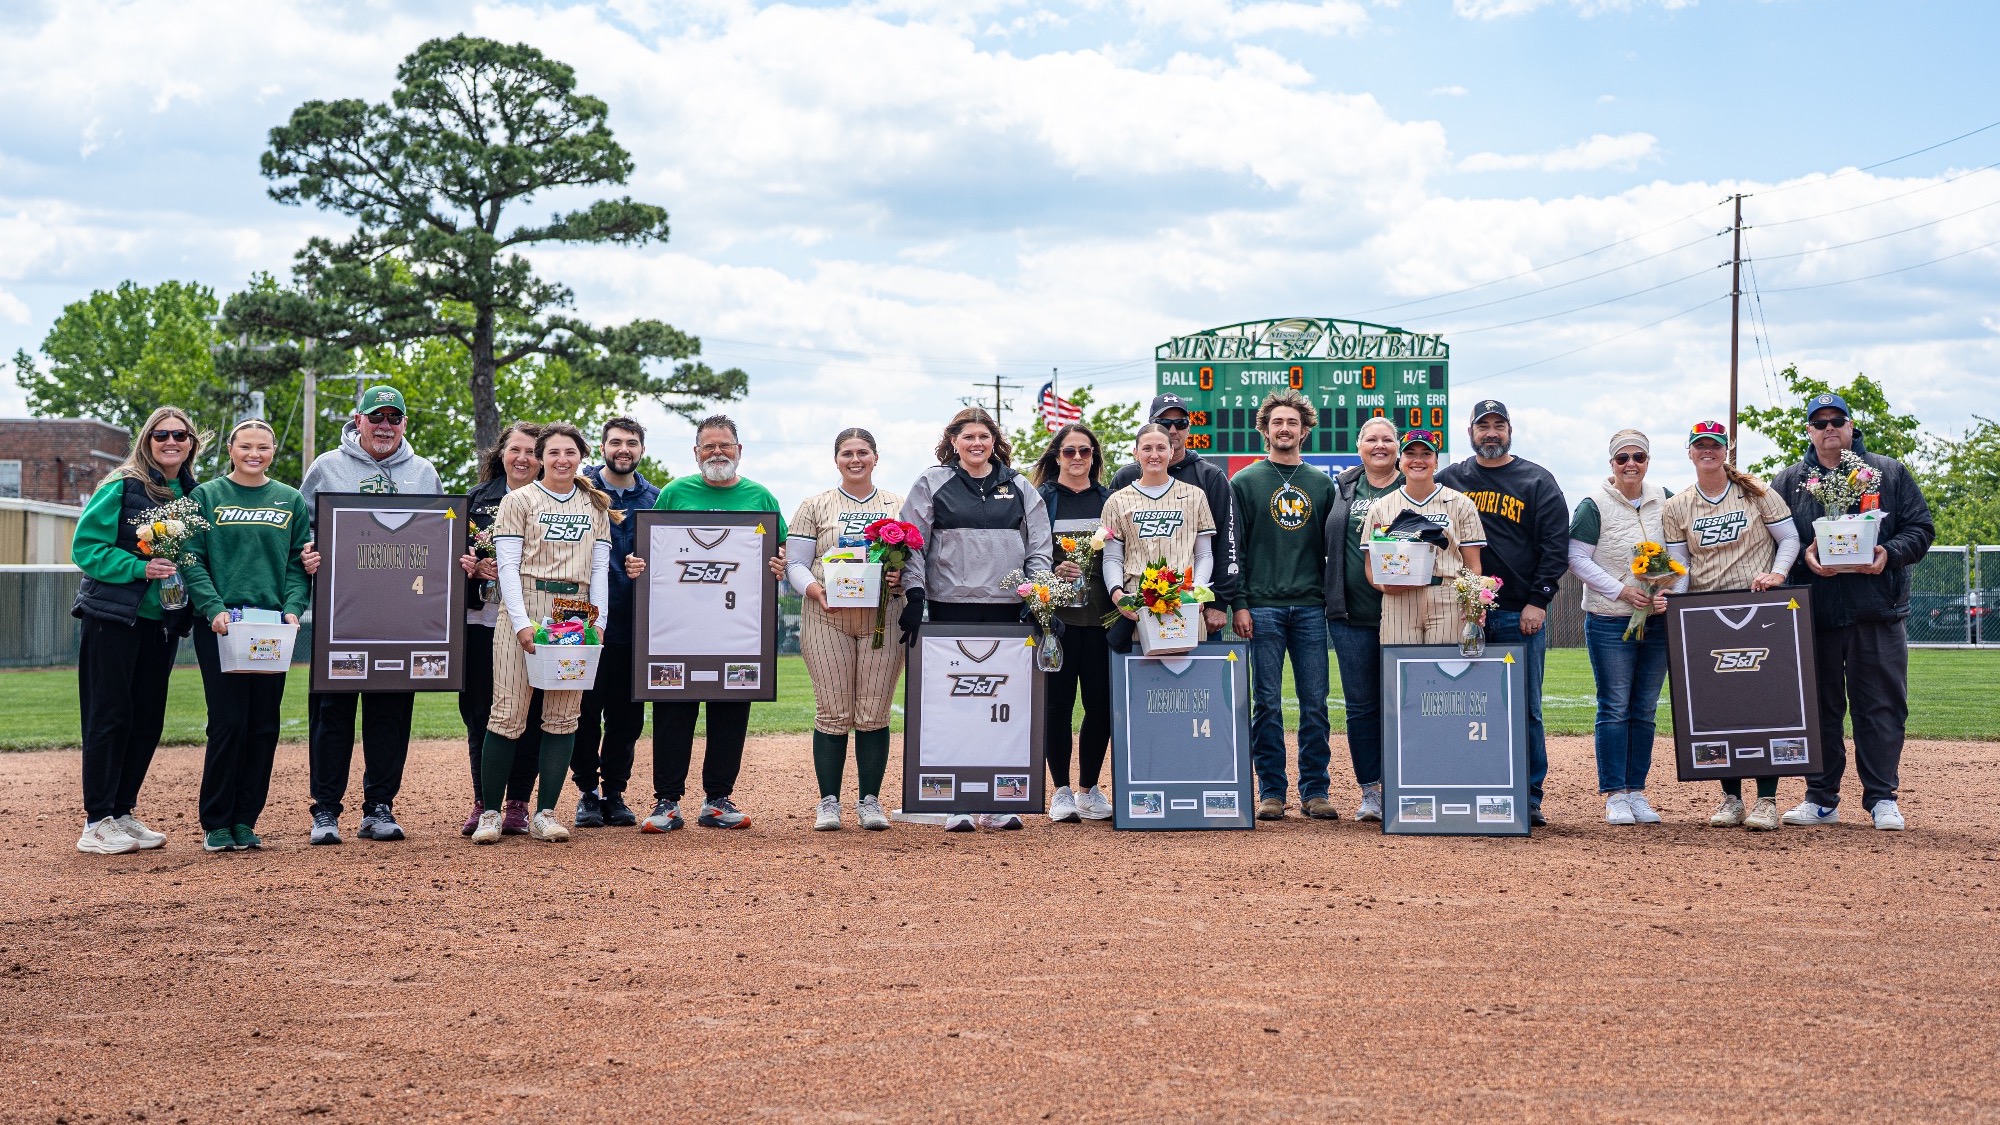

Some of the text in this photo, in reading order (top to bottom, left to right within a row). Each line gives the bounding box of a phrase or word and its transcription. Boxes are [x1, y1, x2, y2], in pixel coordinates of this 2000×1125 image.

[1167, 334, 1443, 360] MINER SOFTBALL
[1162, 365, 1426, 390] BALL 0 STRIKE 0 OUT 0 H/E
[1220, 395, 1227, 407] 1
[1235, 395, 1242, 407] 2
[1251, 395, 1258, 407] 3
[1322, 395, 1329, 407] 7
[1338, 395, 1345, 407] 8
[1356, 394, 1384, 407] RUNS
[1396, 394, 1419, 406] HITS
[1426, 394, 1447, 406] ERR
[1410, 407, 1422, 427] 0
[1431, 407, 1443, 427] 0
[220, 508, 287, 524] MINERS
[540, 513, 589, 524] MISSOURI
[839, 512, 888, 521] MISSOURI
[1133, 511, 1181, 521] MISSOURI
[1500, 494, 1525, 523] S&T
[1140, 520, 1182, 537] S&T
[1280, 518, 1302, 527] ROLLA
[1694, 512, 1743, 529] MISSOURI
[546, 523, 591, 540] S&T
[1701, 520, 1746, 545] S&T
[357, 543, 429, 570] MISSOURI S&T
[680, 562, 737, 582] S&T
[411, 575, 424, 595] 4
[725, 590, 736, 610] 9
[559, 633, 581, 645] erds
[1717, 650, 1765, 670] S&T
[952, 675, 1006, 695] S&T
[1146, 687, 1210, 714] MISSOURI S&T
[1421, 691, 1488, 717] MISSOURI S&T
[990, 703, 1011, 723] 10
[1192, 718, 1211, 738] 14
[1468, 721, 1488, 741] 21
